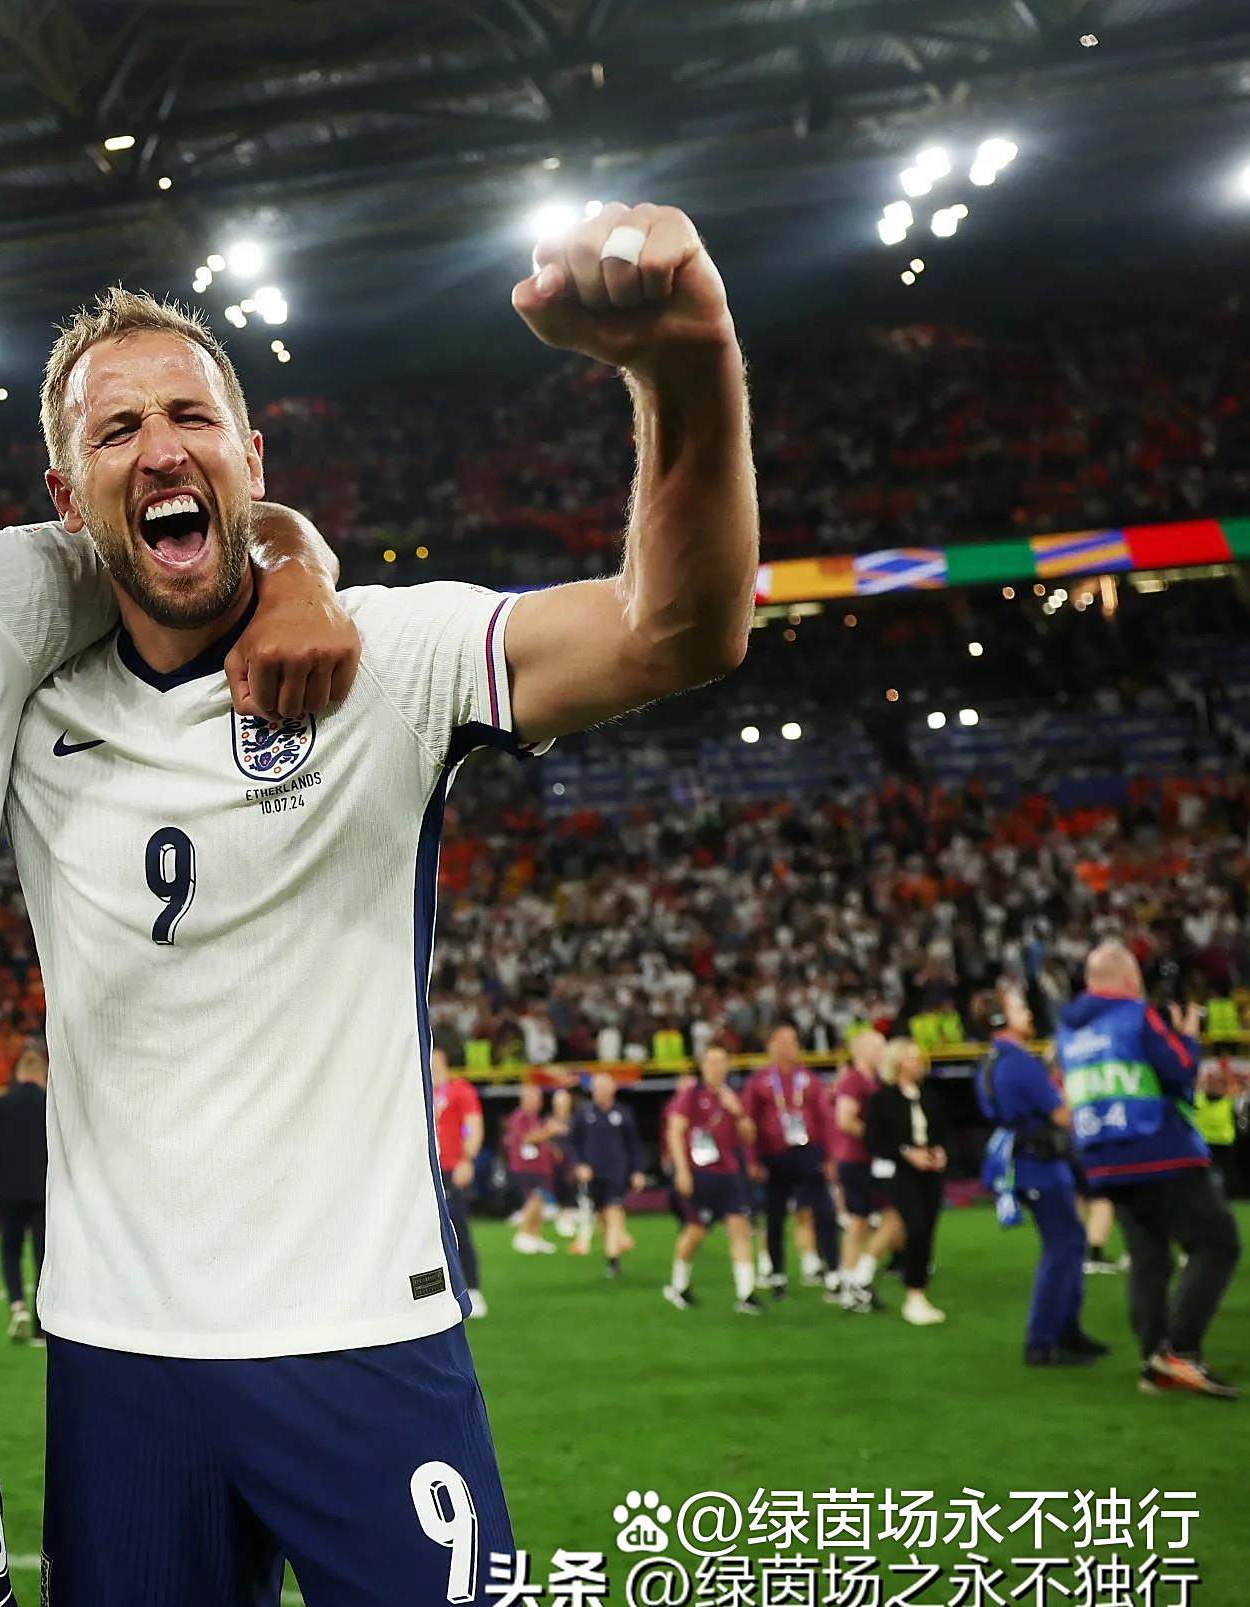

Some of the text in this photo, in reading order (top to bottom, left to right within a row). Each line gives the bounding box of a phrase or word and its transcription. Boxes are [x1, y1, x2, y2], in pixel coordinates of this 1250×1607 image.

[245, 772, 322, 801] ETHERLANDS
[259, 794, 305, 815] 10.07.24
[145, 826, 196, 945] 9
[410, 1460, 479, 1605] 9
